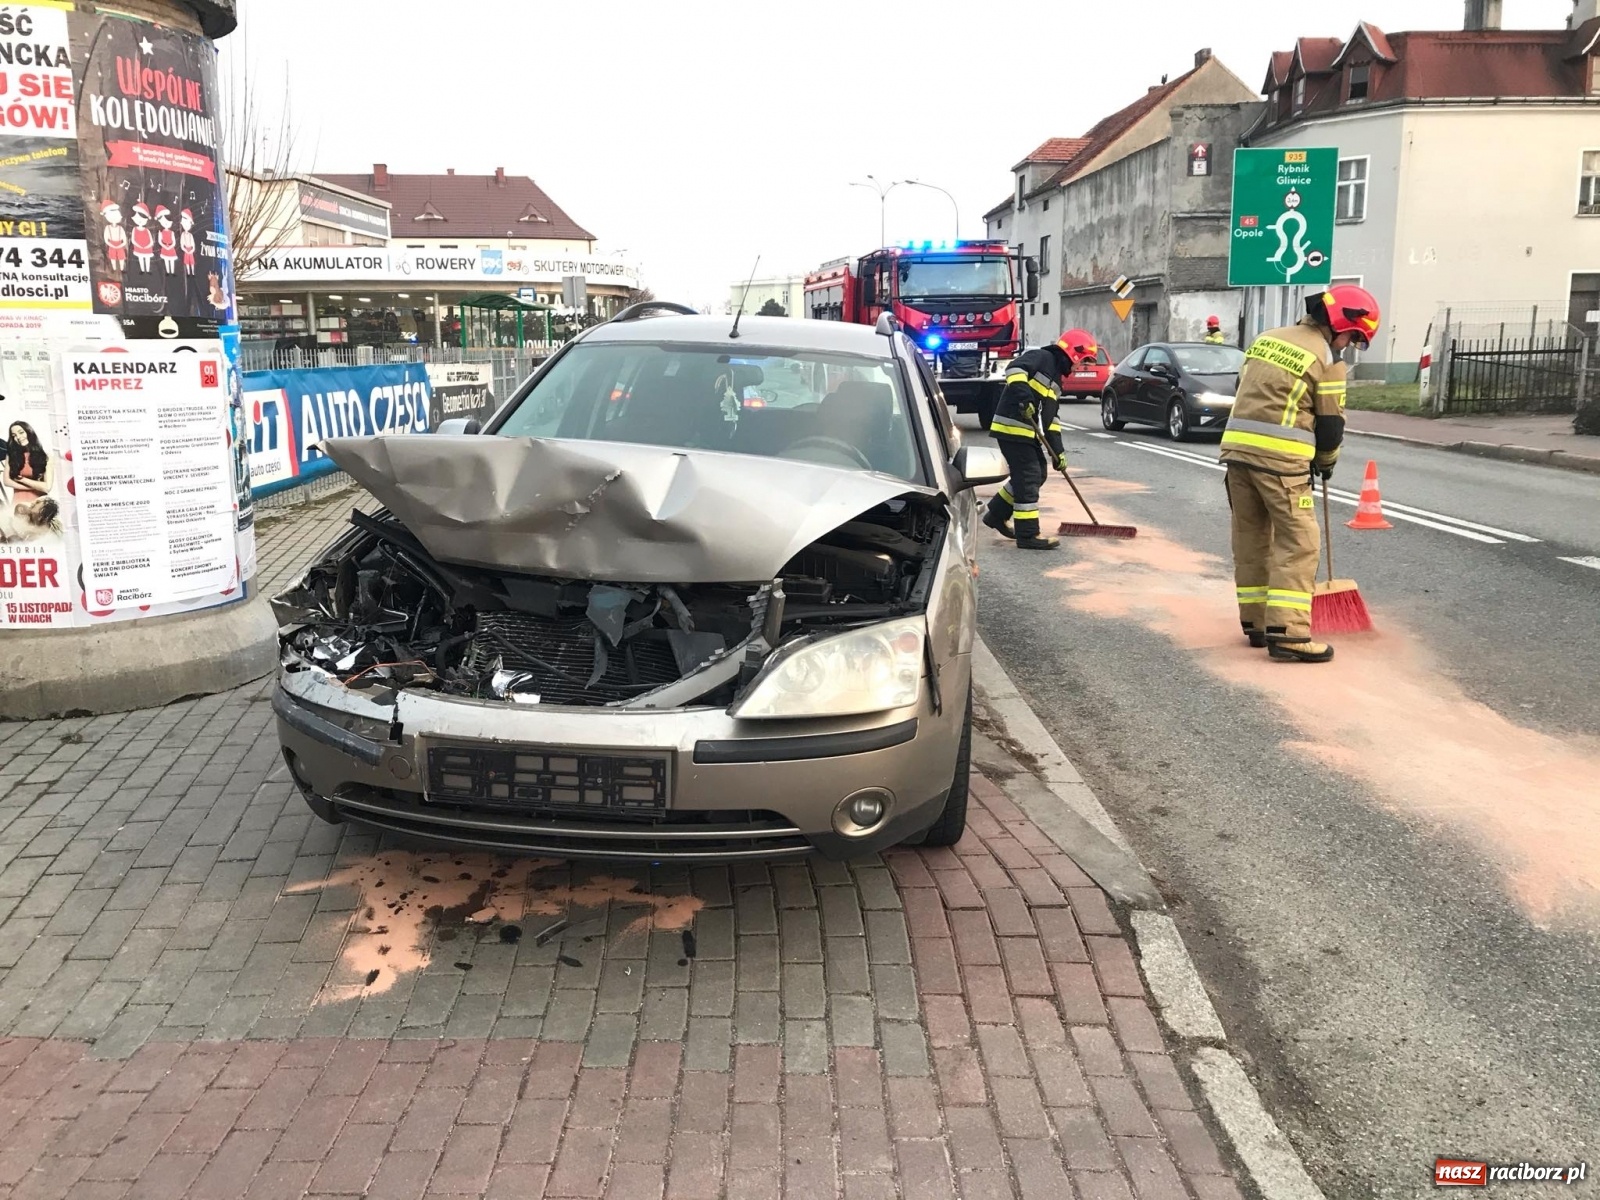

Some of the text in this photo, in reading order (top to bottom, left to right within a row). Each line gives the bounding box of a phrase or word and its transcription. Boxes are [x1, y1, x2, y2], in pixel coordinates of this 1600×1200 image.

[90, 94, 217, 149] KOLĘDOWANIE!
[31, 147, 68, 159] telefony
[1288, 153, 1304, 161] 935
[1277, 163, 1310, 175] Rybnik
[1276, 175, 1312, 185] Gliwice
[1244, 217, 1255, 225] 45
[18, 221, 37, 236] CI
[1234, 228, 1263, 239] Opole
[31, 247, 85, 268] 344
[258, 257, 382, 270] NA AKUMULATOR
[416, 257, 476, 270] ROWERY
[534, 260, 578, 272] SKUTERY
[126, 293, 168, 303] Racibórz
[73, 362, 177, 374] KALENDARZ
[203, 365, 214, 374] 01
[75, 378, 143, 391] IMPREZ
[204, 375, 215, 384] 20
[301, 389, 365, 462] AUTO
[250, 463, 265, 477] auto
[116, 592, 152, 601] Racibórz
[5, 602, 17, 613] 15
[8, 613, 52, 623] W KINACH
